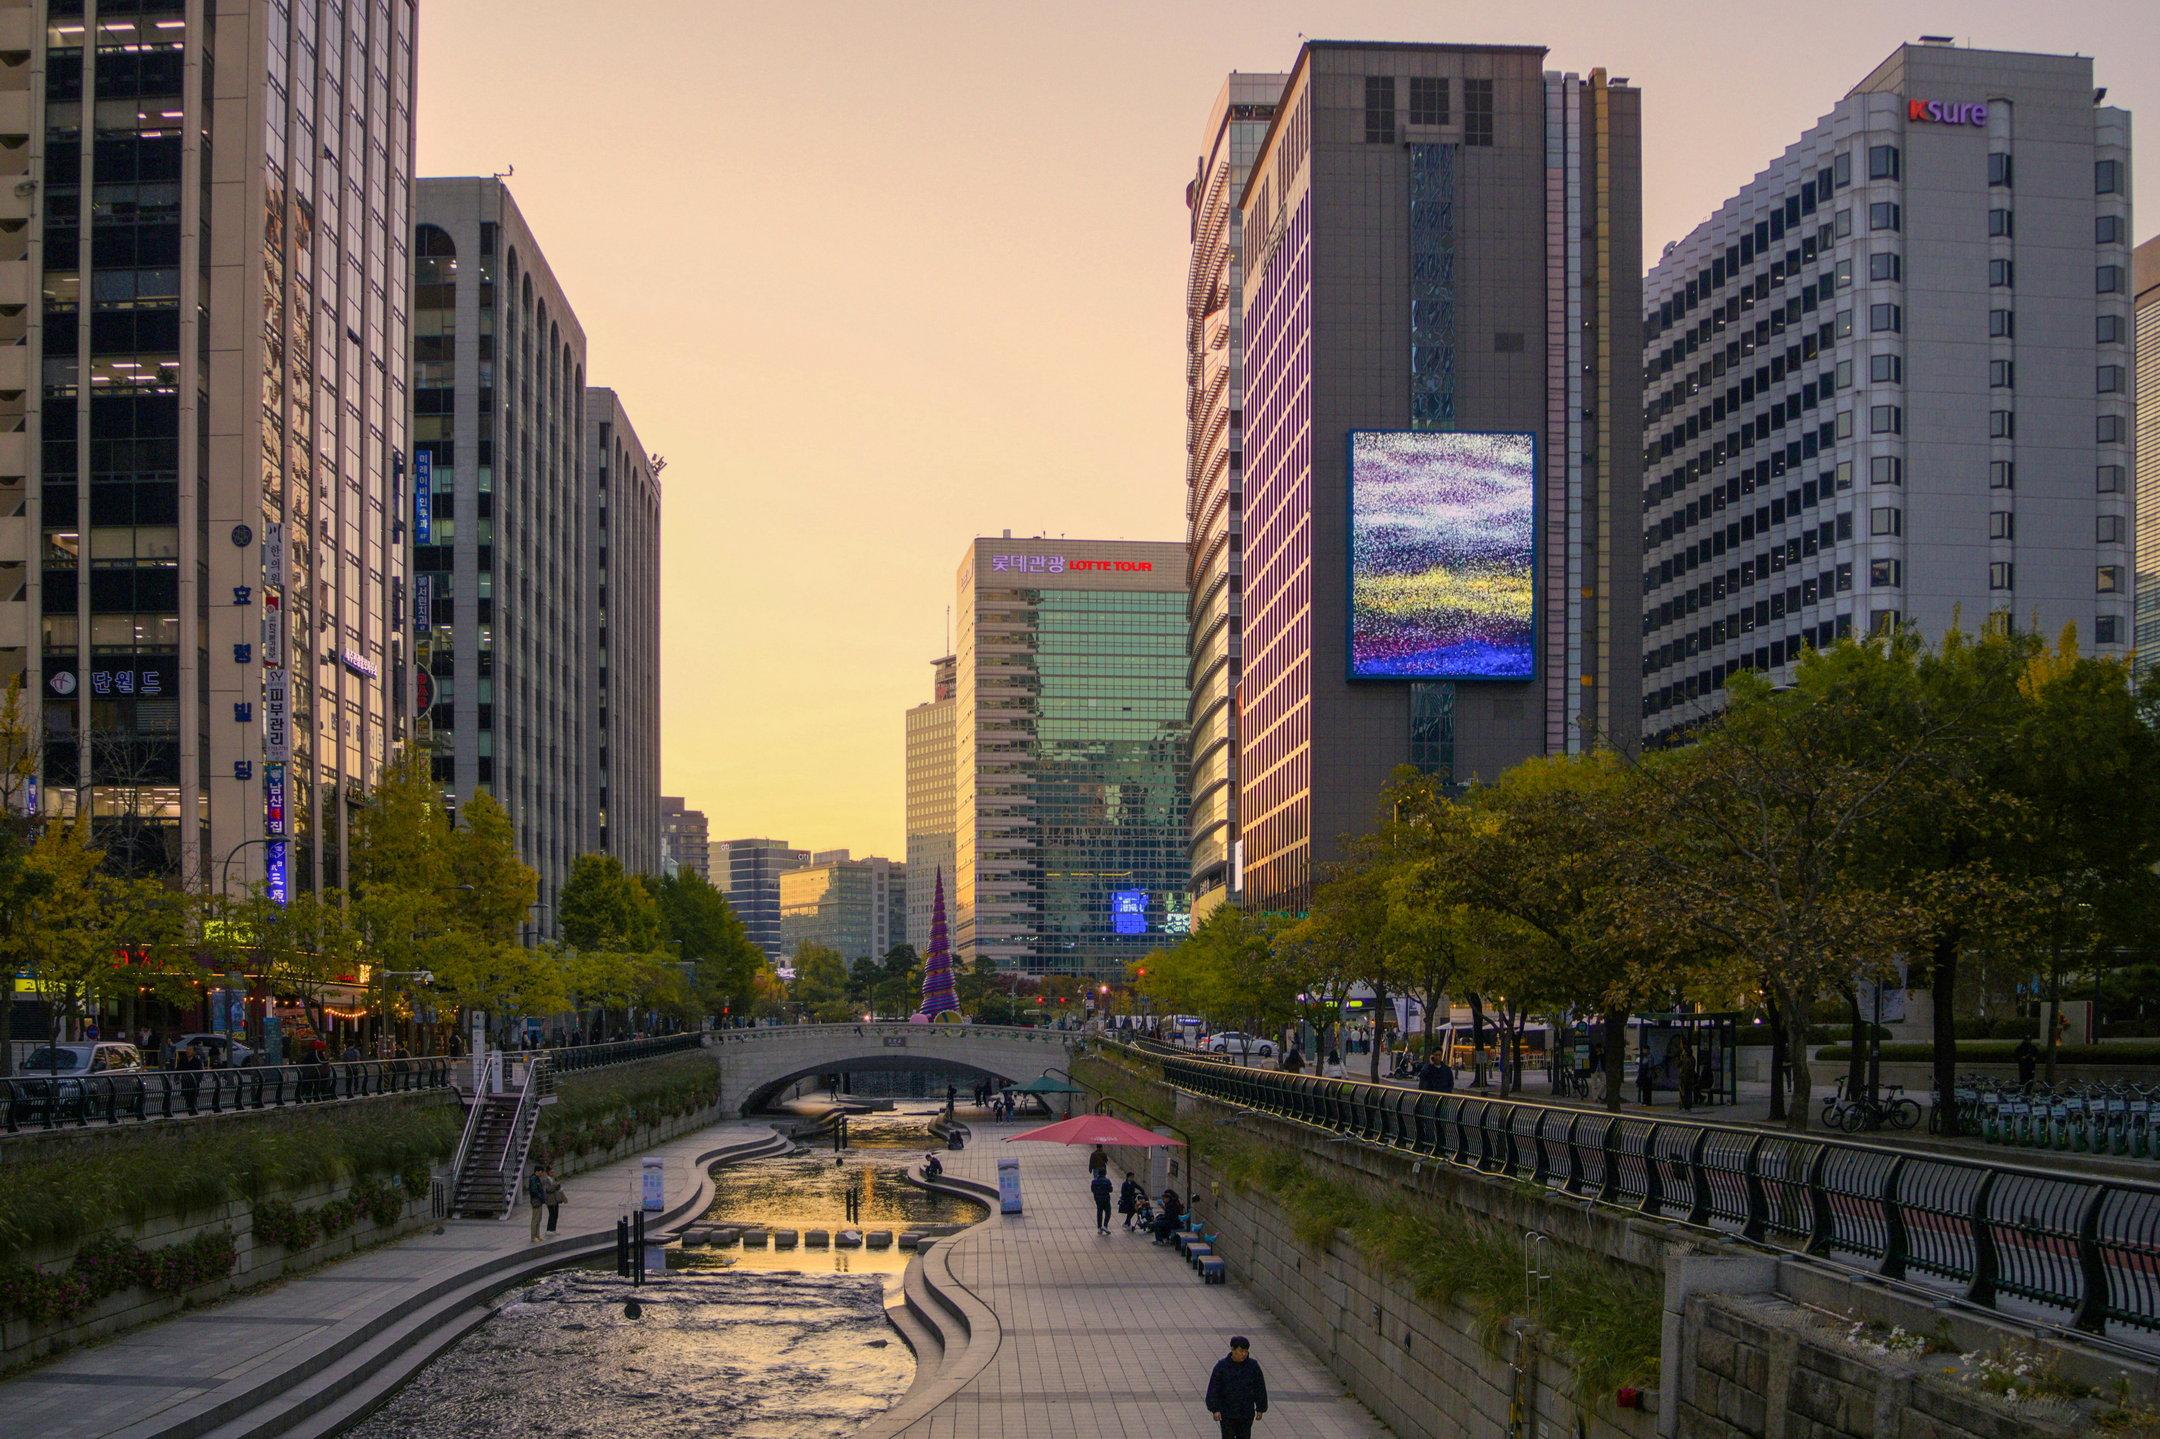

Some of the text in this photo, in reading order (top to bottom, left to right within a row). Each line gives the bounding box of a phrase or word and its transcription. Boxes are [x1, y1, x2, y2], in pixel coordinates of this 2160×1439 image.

[1909, 98, 1988, 127] Ksure
[419, 454, 428, 528] 미래이비인후과
[992, 554, 1152, 573] 롯데관광 LOTTE TOUR
[92, 671, 161, 693] 단월드
[270, 688, 284, 746] 피부관리
